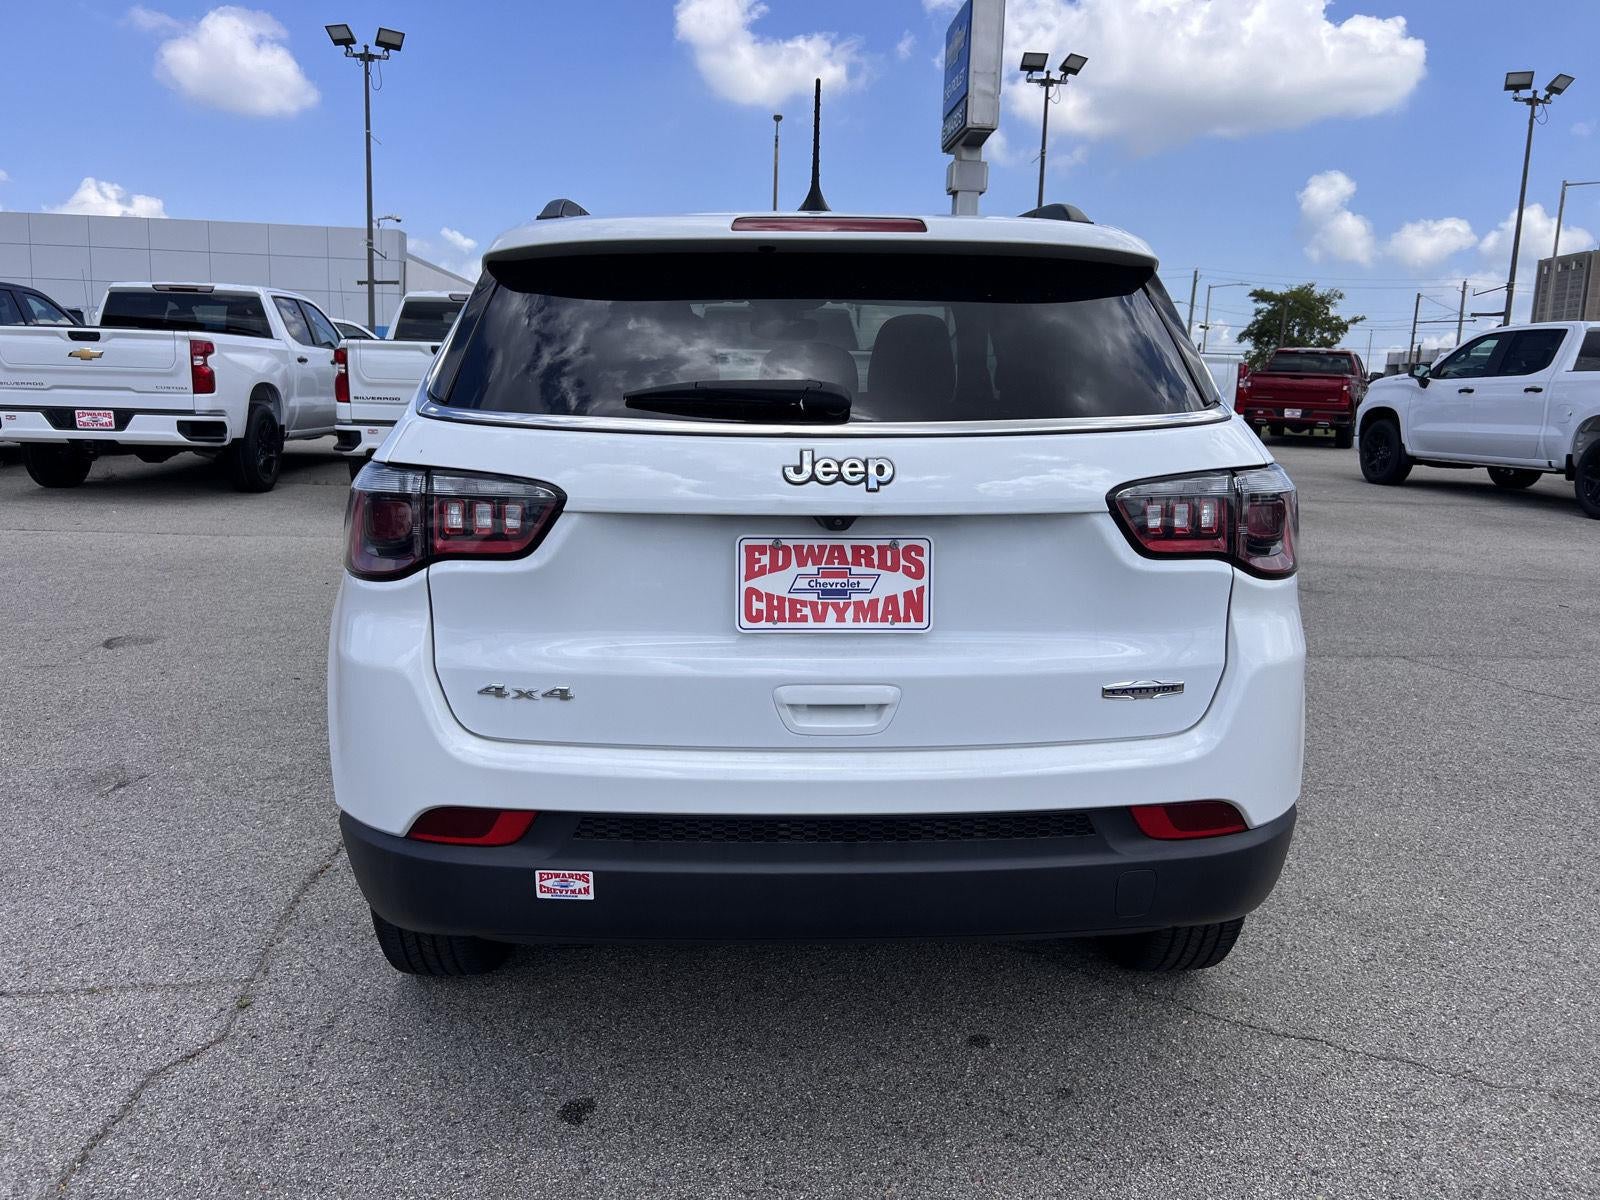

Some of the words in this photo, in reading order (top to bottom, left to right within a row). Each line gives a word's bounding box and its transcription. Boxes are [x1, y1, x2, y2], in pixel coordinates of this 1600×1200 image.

[77, 411, 112, 419] EDWARDS
[78, 419, 113, 427] CHEVYMAN
[783, 448, 895, 492] Jeep
[744, 544, 925, 582] EDWARDS
[807, 579, 861, 589] Chevrolet
[744, 585, 925, 624] CHEVYMAN
[477, 683, 575, 701] 4x4
[538, 872, 590, 884] EDWARDS
[539, 883, 590, 895] CHEVYMAN
